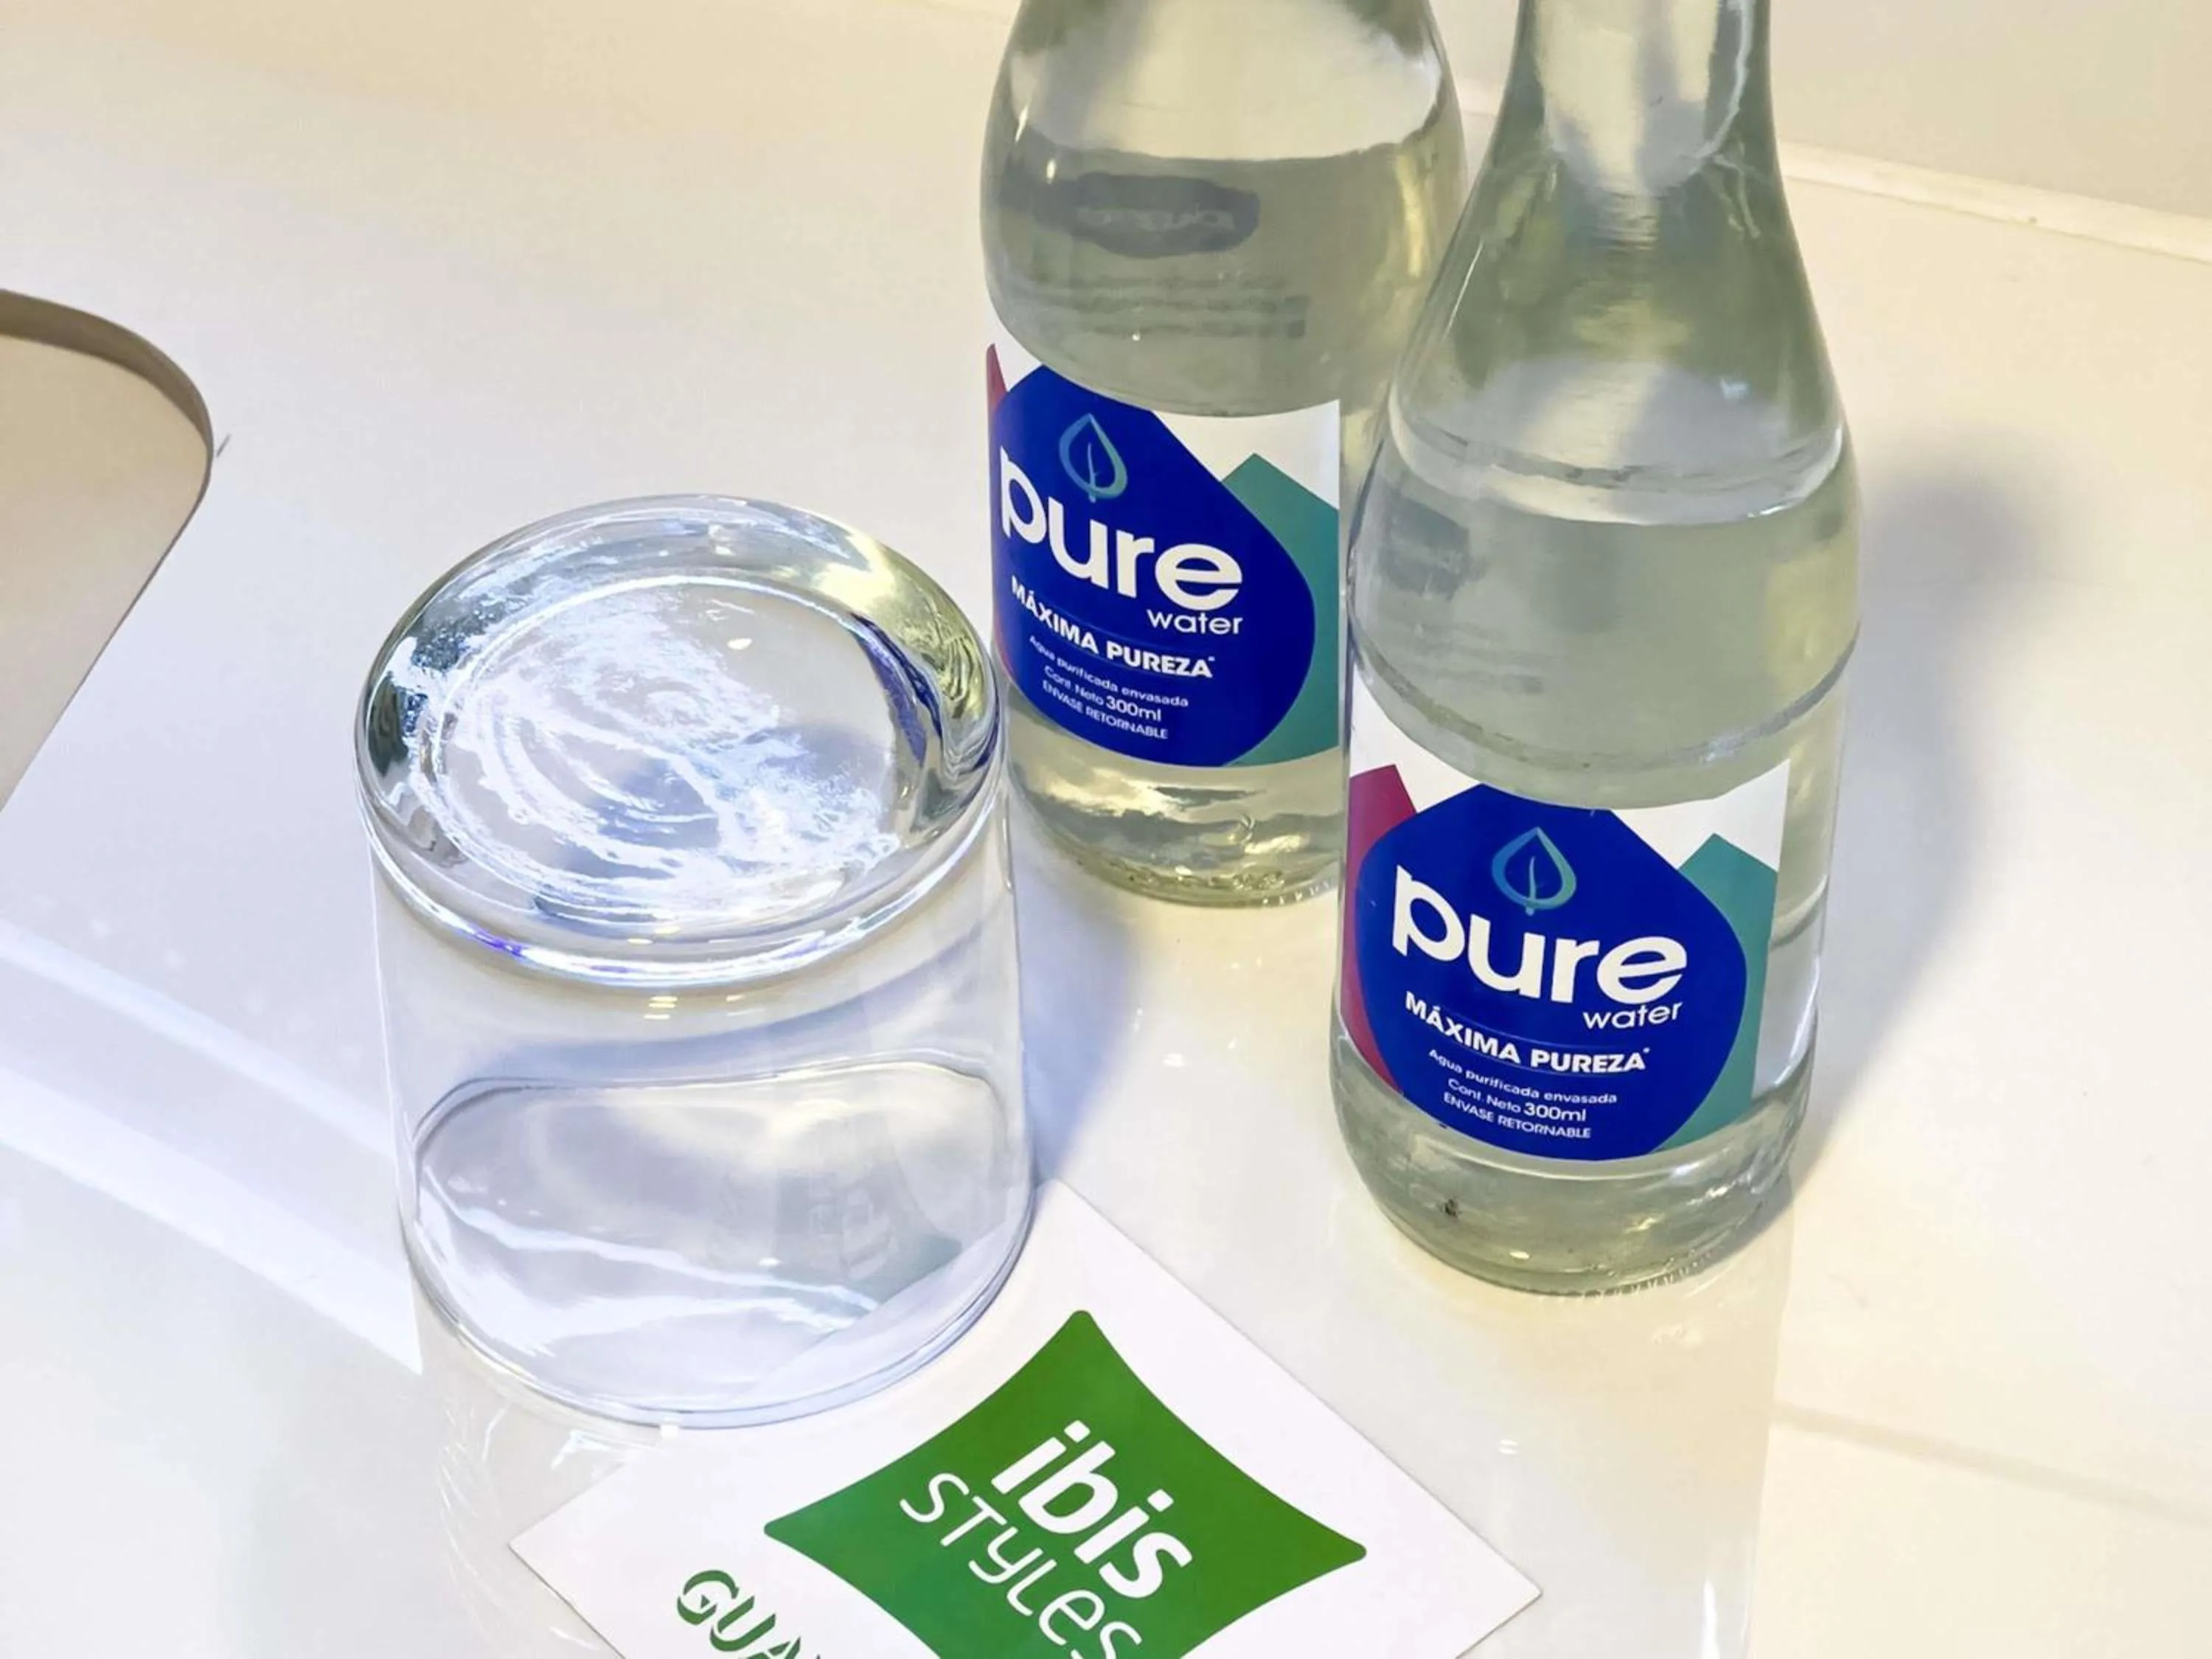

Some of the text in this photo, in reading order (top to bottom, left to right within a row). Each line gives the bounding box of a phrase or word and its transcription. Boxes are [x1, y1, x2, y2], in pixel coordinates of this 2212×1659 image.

[1000, 445, 1243, 611] pure
[1012, 574, 1099, 655] MÁXIMA
[1147, 609, 1244, 635] water
[1043, 679, 1169, 740] ENVASE RETORNABLE
[1057, 657, 1119, 693] purificada
[1121, 686, 1189, 708] envasada
[1106, 695, 1161, 722] 300ml
[1392, 864, 1688, 1004] pure
[1405, 991, 1521, 1064] MÁXIMA
[1582, 1002, 1683, 1029] water
[1428, 1049, 1617, 1104] Agua purificada envasada
[1444, 1092, 1591, 1139] ENVASE RETORNABLE
[1486, 1094, 1521, 1113] Neto
[1523, 1102, 1586, 1122] 300ml
[991, 1419, 1193, 1599] ibis
